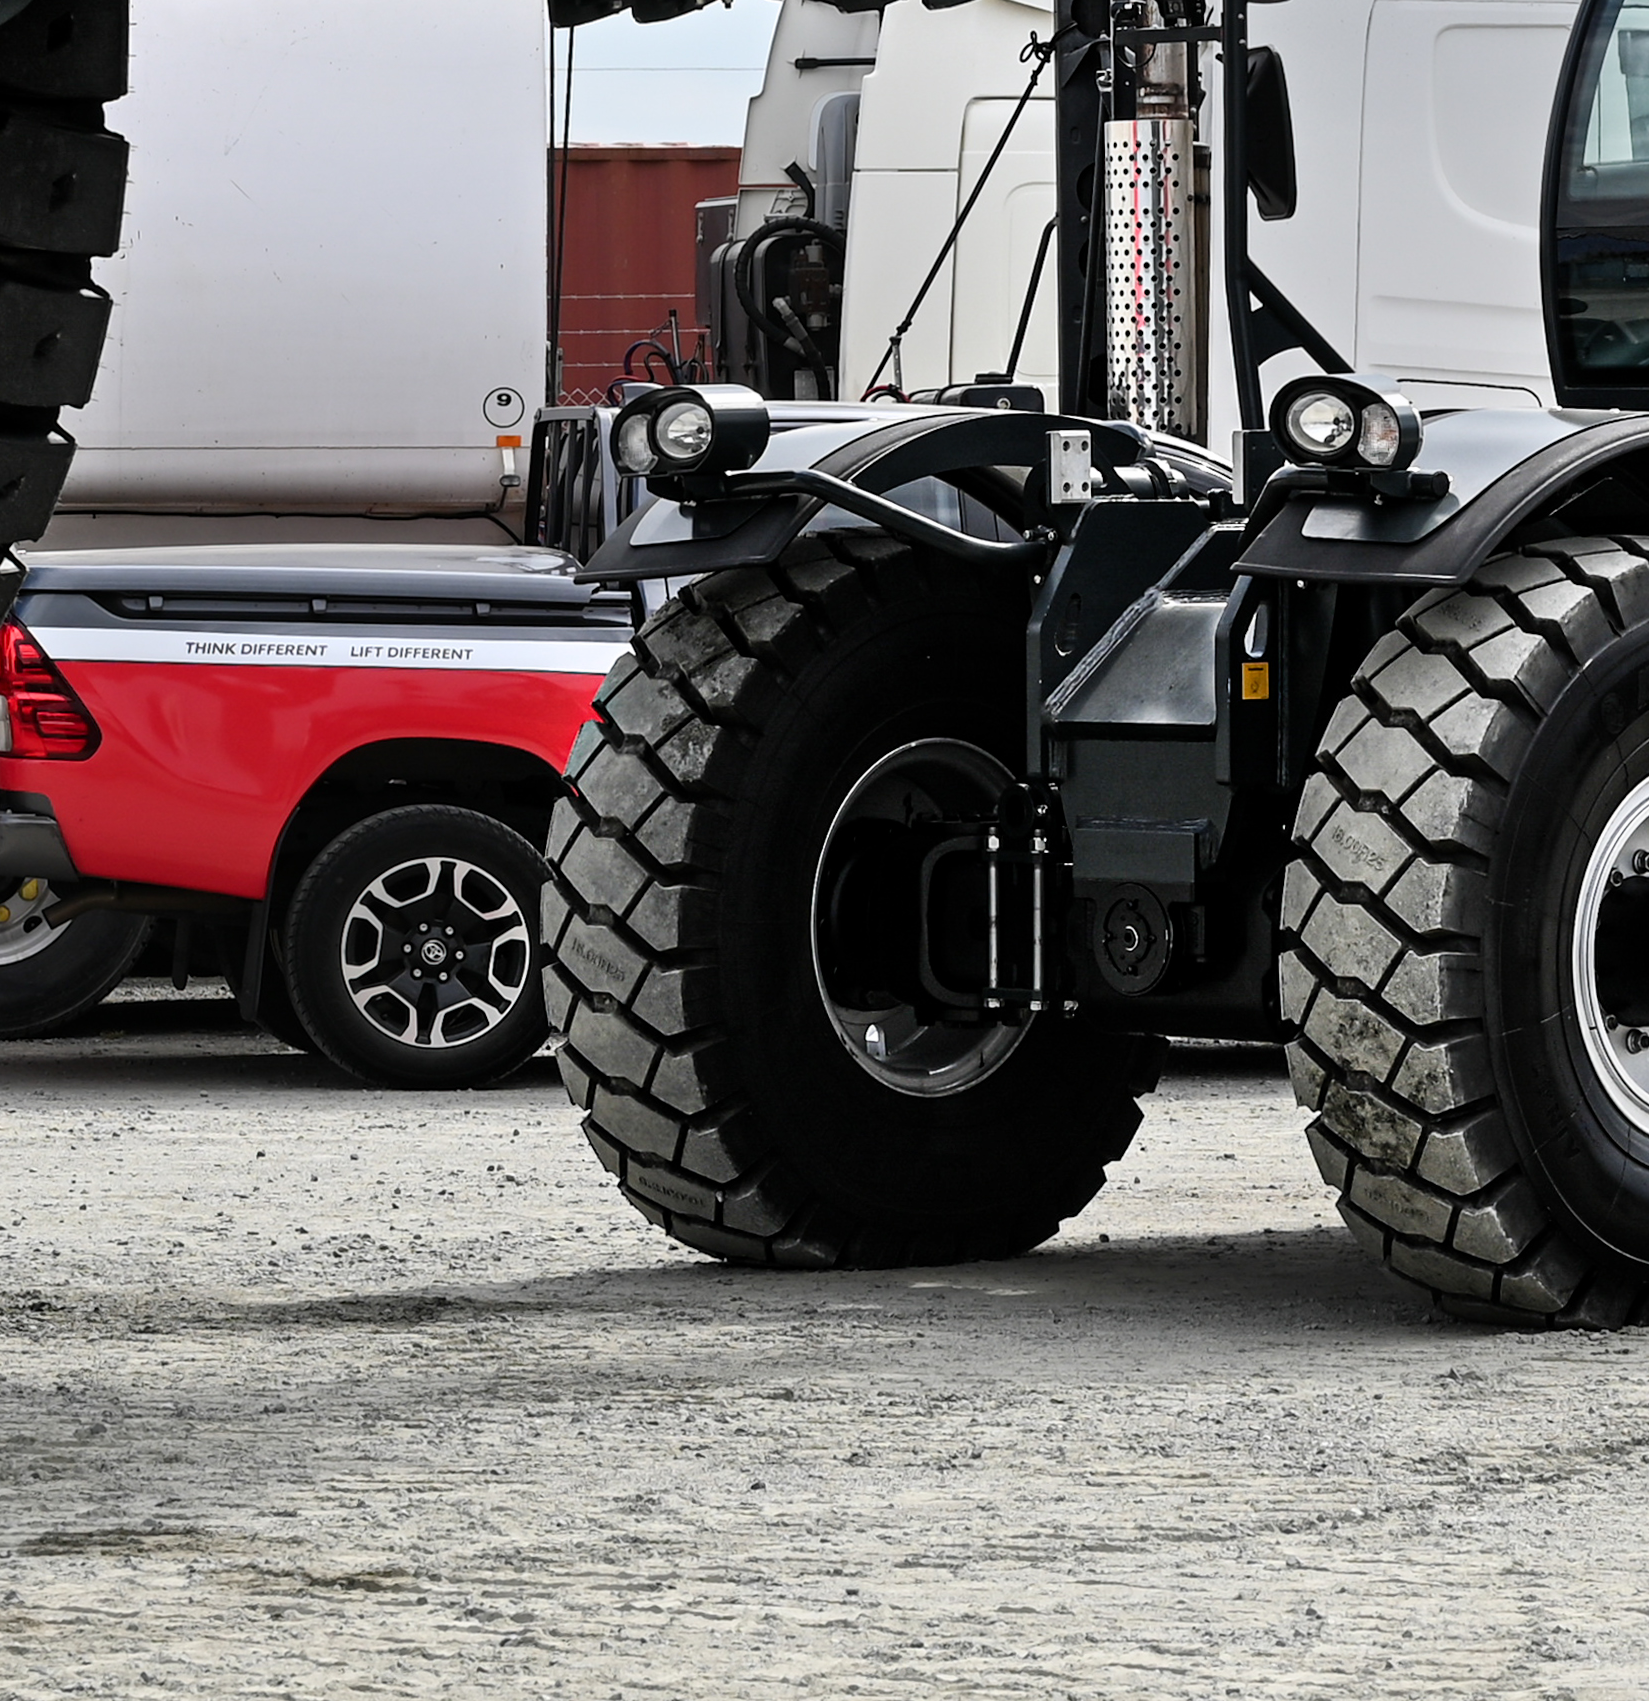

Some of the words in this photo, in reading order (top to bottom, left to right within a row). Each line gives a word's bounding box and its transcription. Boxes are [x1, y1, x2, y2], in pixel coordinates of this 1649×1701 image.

[185, 642, 236, 655] THINK
[240, 643, 328, 657] DIFFERENT
[350, 646, 384, 658] LIFT
[387, 647, 474, 660] DIFFERENT
